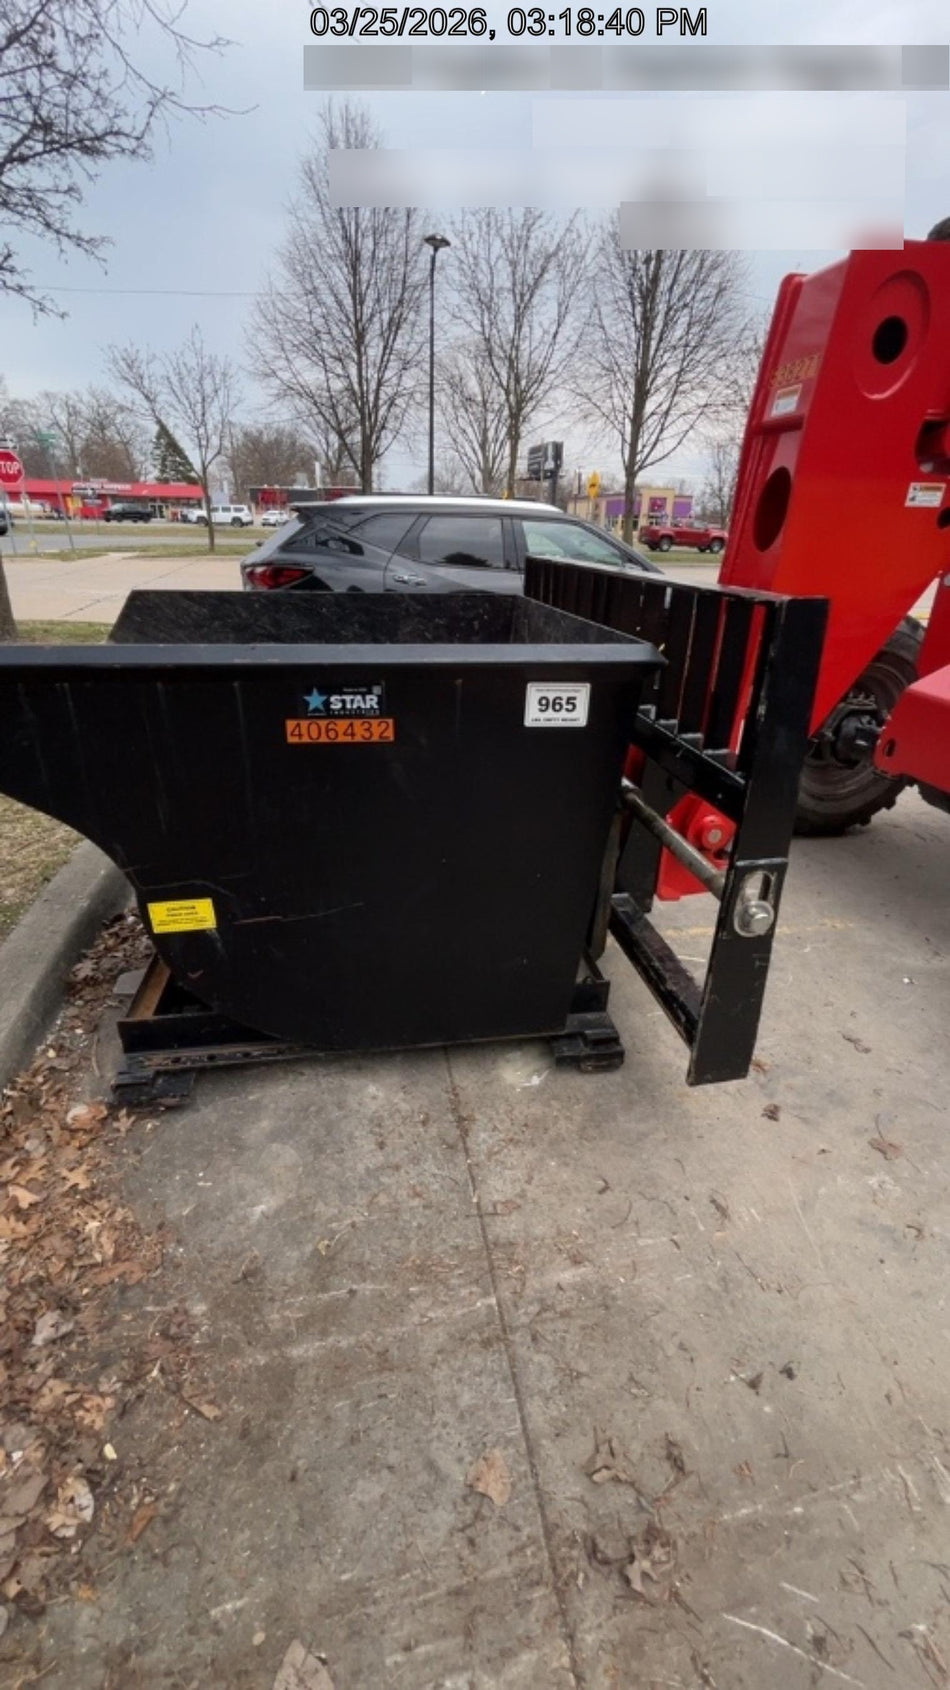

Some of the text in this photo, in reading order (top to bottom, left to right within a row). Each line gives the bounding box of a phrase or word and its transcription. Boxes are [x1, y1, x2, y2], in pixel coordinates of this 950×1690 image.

[0, 461, 20, 474] TOP
[330, 694, 379, 709] STAR
[537, 696, 577, 713] 965
[289, 720, 391, 741] 406432
